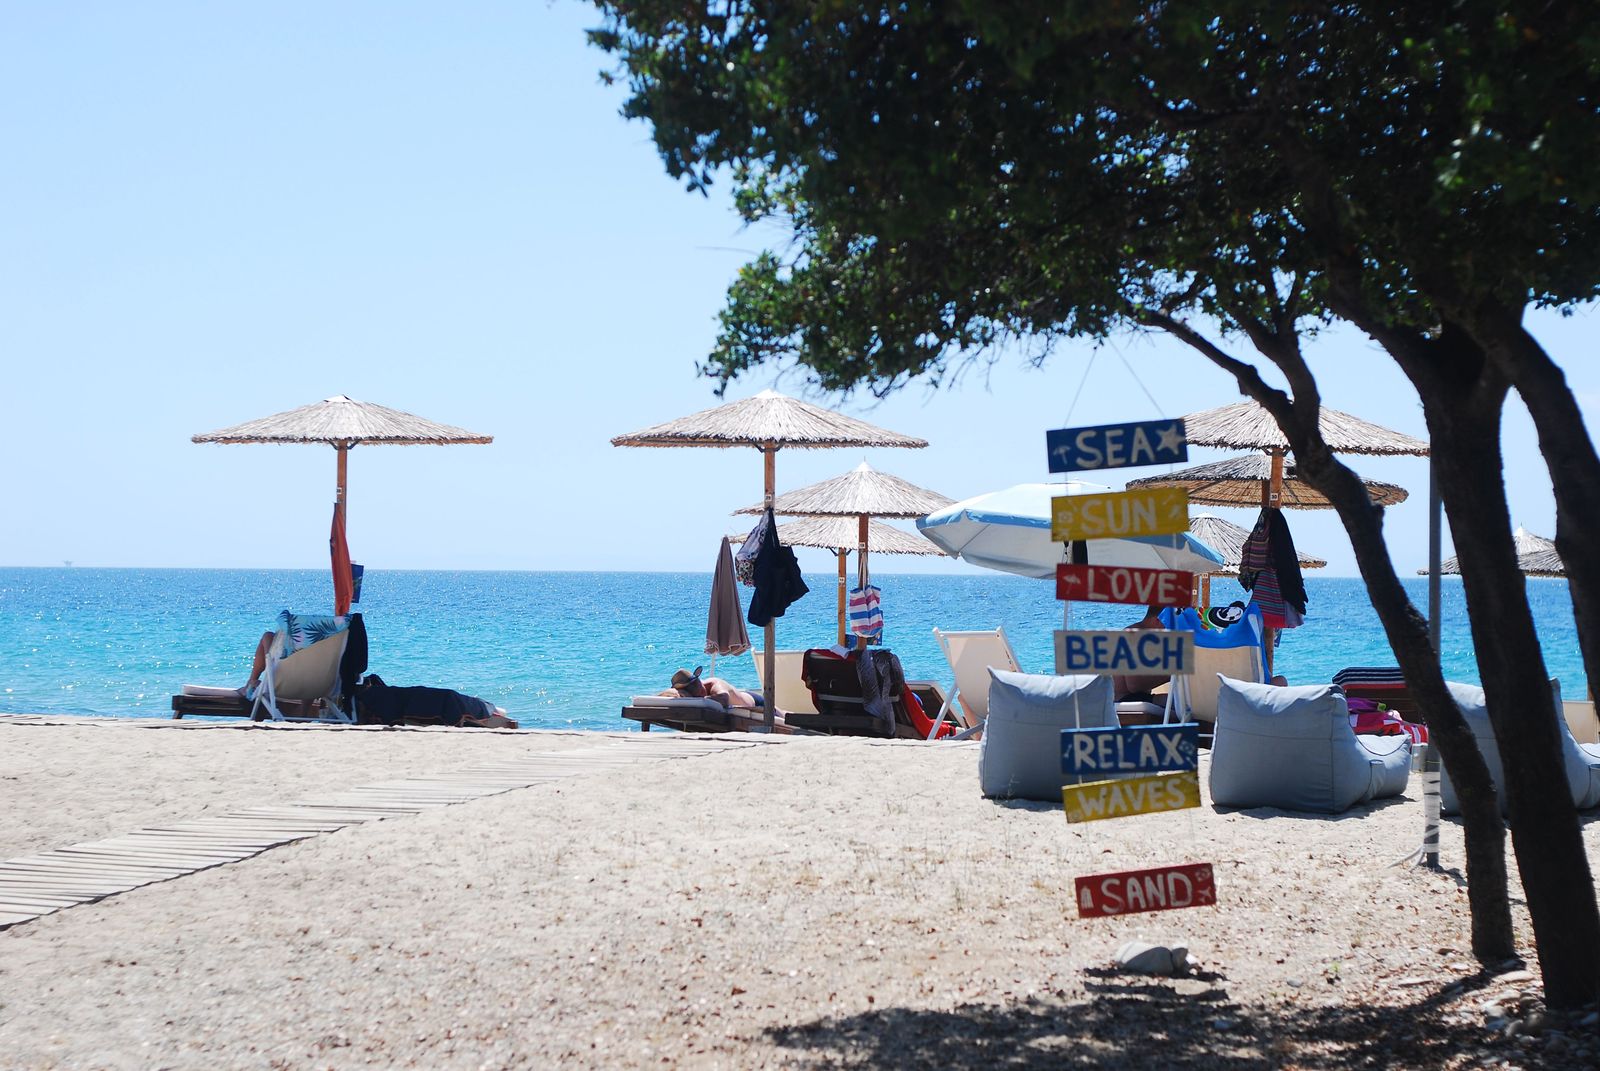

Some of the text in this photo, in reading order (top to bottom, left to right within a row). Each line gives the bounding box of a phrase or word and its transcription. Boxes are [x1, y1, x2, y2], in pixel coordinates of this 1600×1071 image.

[1075, 426, 1155, 468] SEA
[1081, 497, 1157, 535] SUN
[1087, 568, 1177, 604] LOVE
[1065, 634, 1184, 670] BEACH
[1072, 733, 1185, 770] RELAX
[1077, 778, 1185, 817] WAVES
[1101, 871, 1193, 914] SAND
